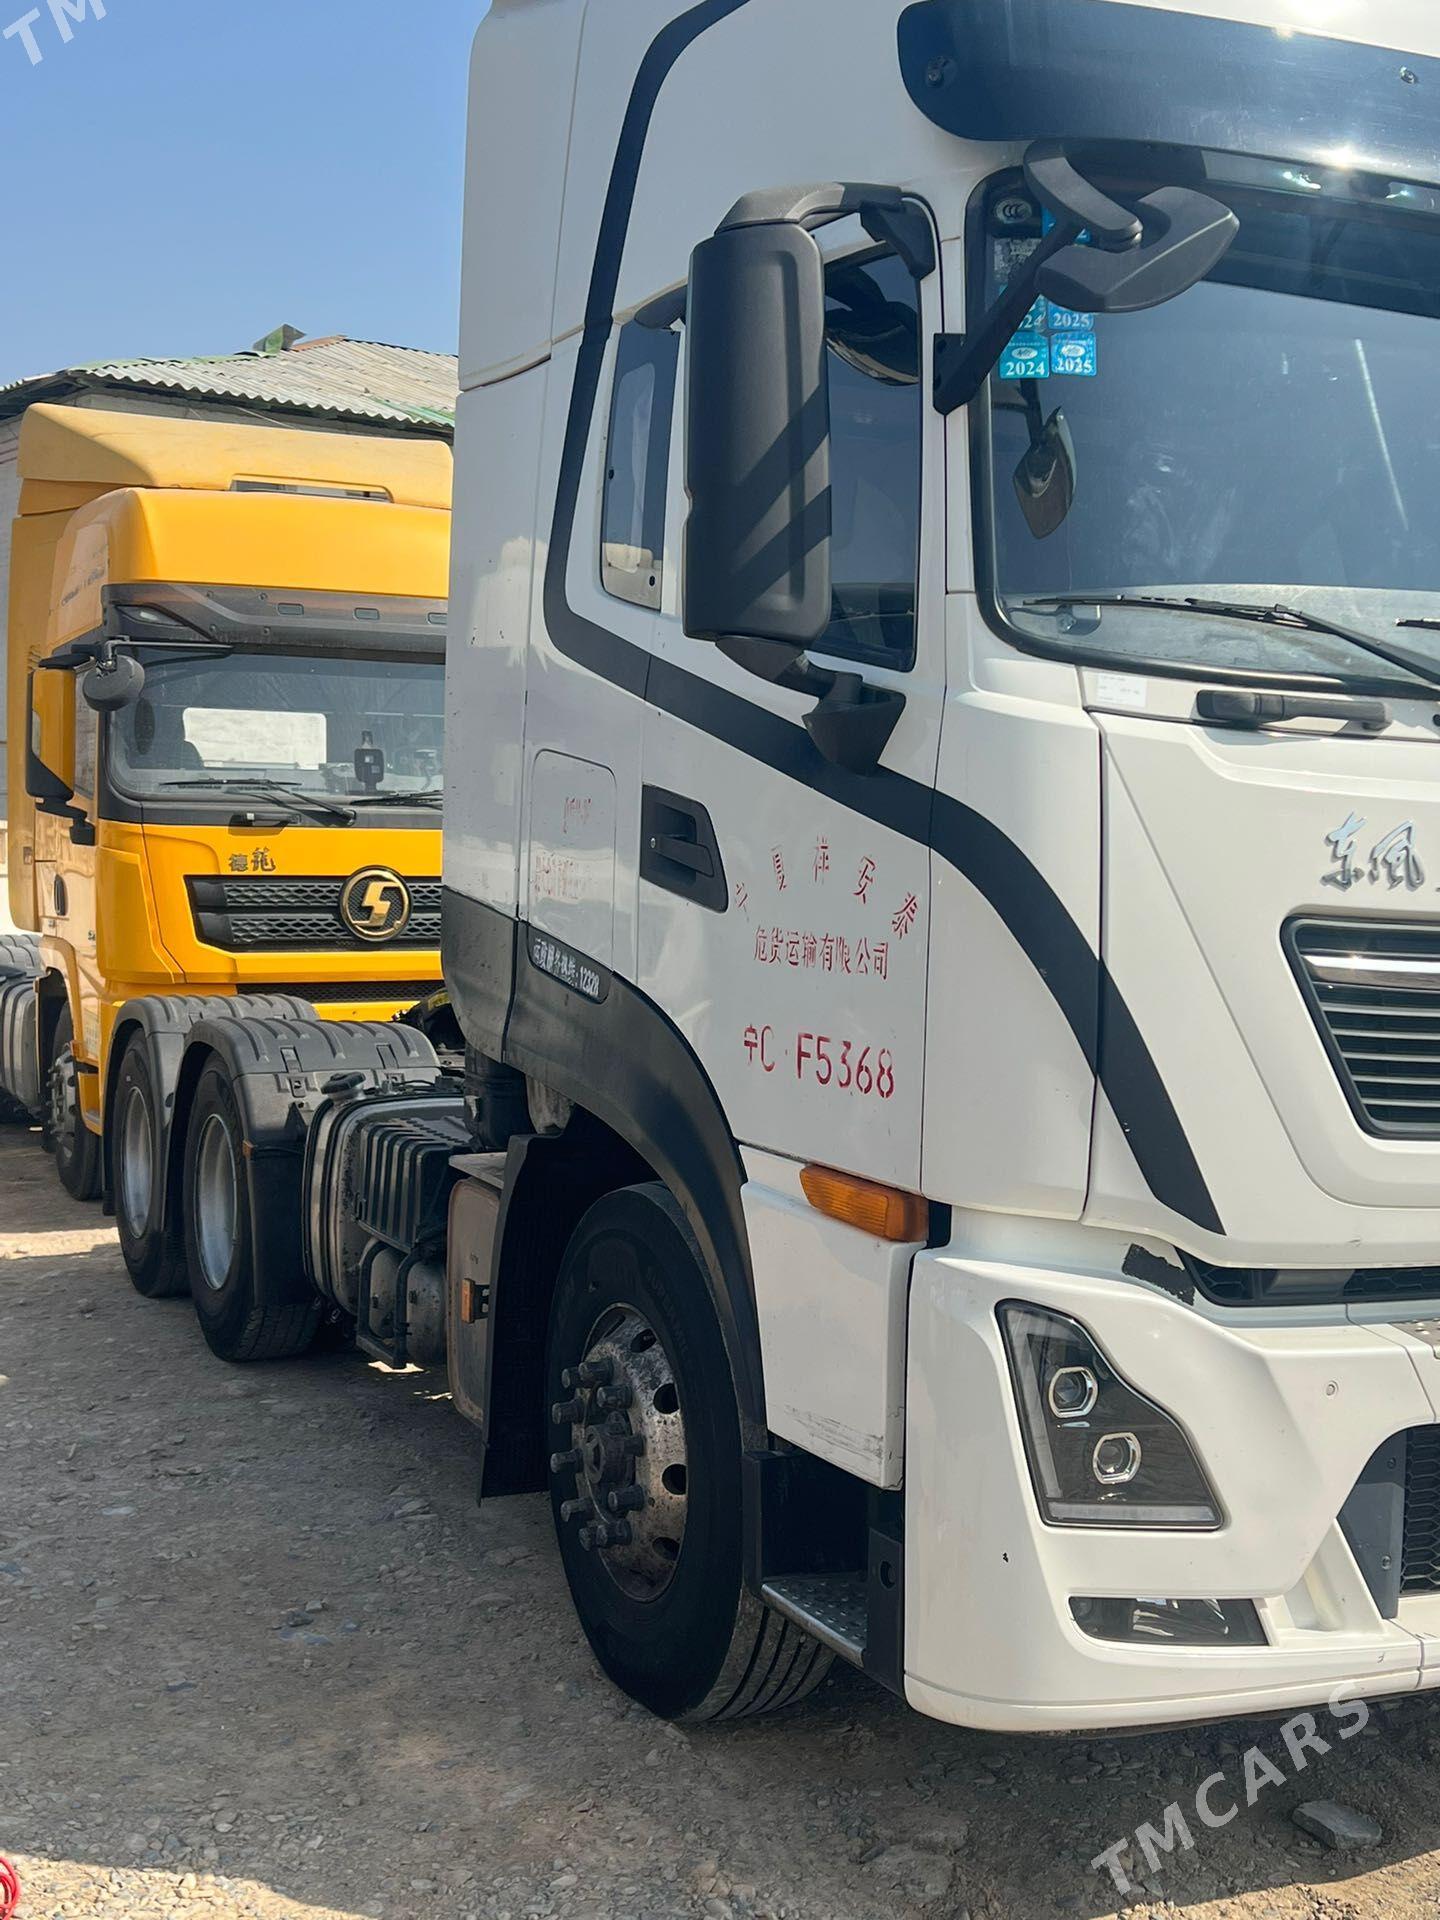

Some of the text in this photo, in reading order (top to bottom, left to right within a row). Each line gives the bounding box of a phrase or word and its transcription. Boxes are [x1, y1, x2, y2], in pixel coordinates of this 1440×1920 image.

[1053, 312, 1091, 328] 2025
[1005, 360, 1045, 377] 2024
[1054, 356, 1093, 375] 2025
[754, 924, 889, 981] 危货运输有限公司
